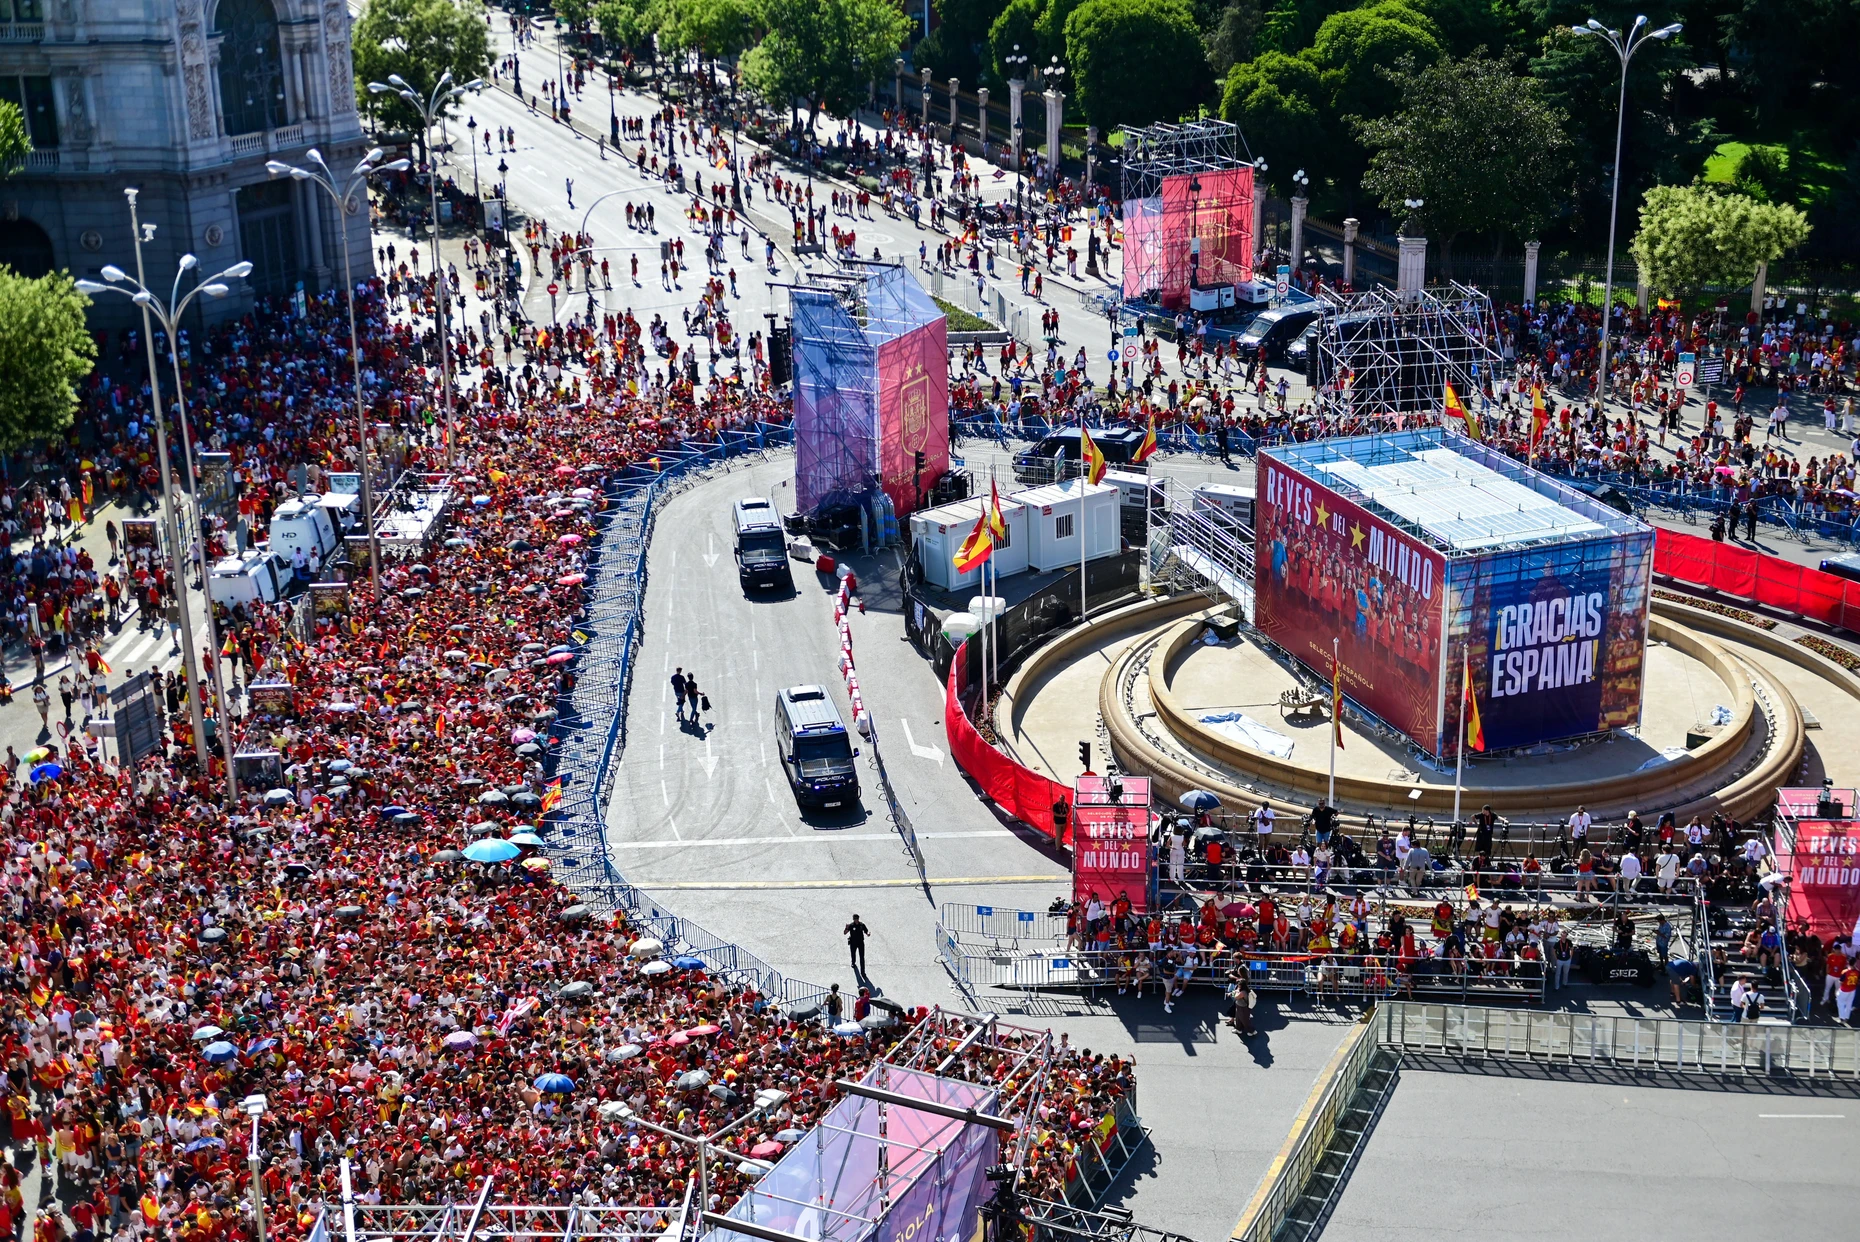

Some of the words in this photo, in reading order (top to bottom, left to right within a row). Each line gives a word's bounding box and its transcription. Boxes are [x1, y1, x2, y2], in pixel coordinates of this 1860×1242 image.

[1266, 466, 1313, 526] REYES
[1333, 512, 1346, 537] DEL
[1368, 525, 1433, 600] MUNDO
[1309, 641, 1342, 667] SELECCIN
[1342, 662, 1374, 690] ESPAÑOLA
[1325, 661, 1333, 671] DE
[1491, 634, 1599, 699] ESPAÑA!
[1090, 821, 1134, 840] REYES
[1104, 841, 1118, 850] DEL
[1810, 835, 1857, 855] REYES
[1083, 851, 1139, 869] MUNDO
[1823, 856, 1838, 867] DEL
[1799, 867, 1860, 885] MUNDO
